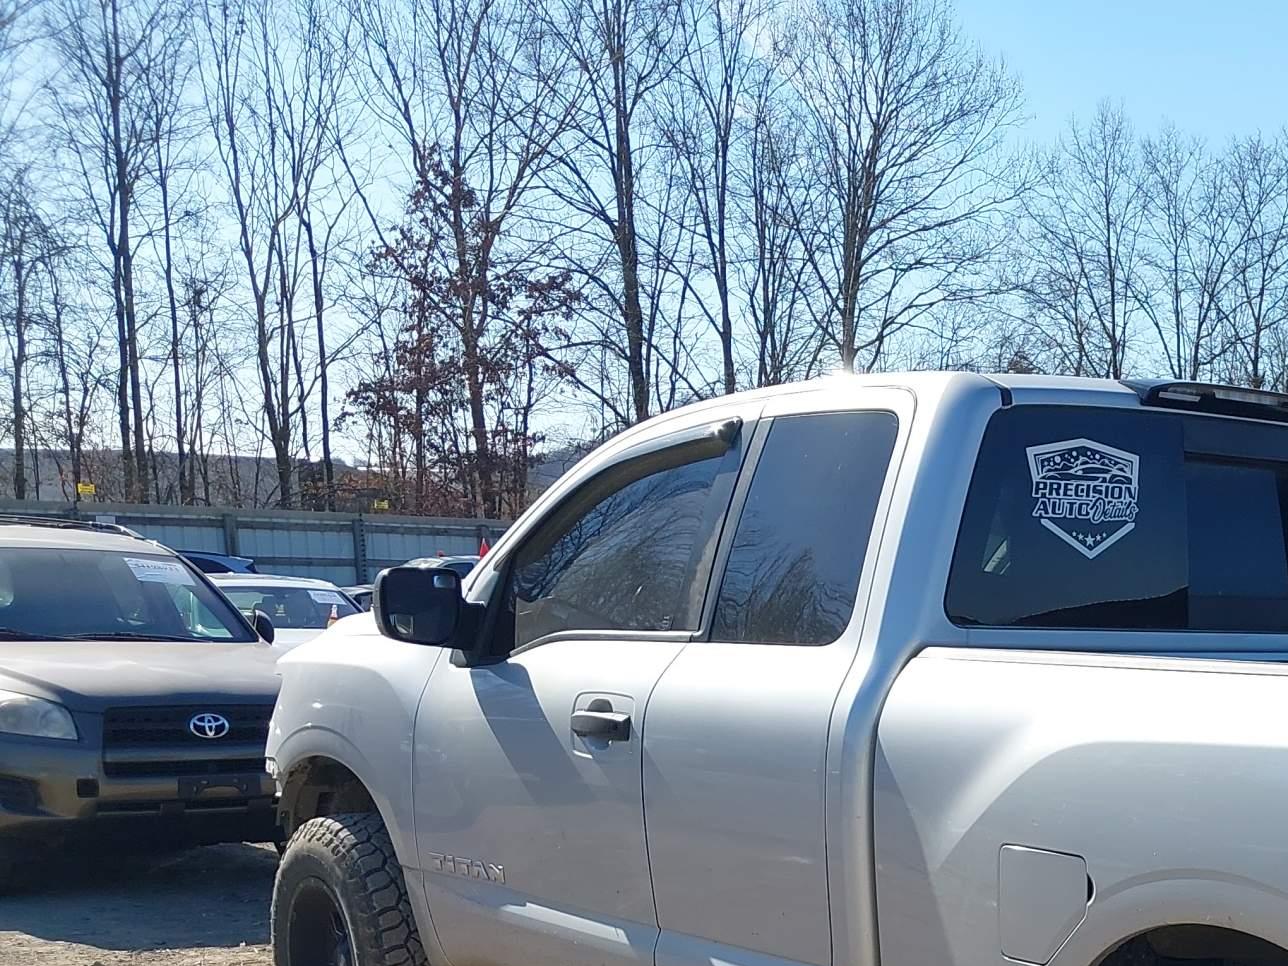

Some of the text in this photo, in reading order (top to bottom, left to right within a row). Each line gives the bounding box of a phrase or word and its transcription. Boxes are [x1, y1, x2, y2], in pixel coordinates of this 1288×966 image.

[1033, 480, 1139, 501] PRECISION
[1033, 497, 1140, 523] AUTO Details
[427, 851, 506, 884] TITAN
